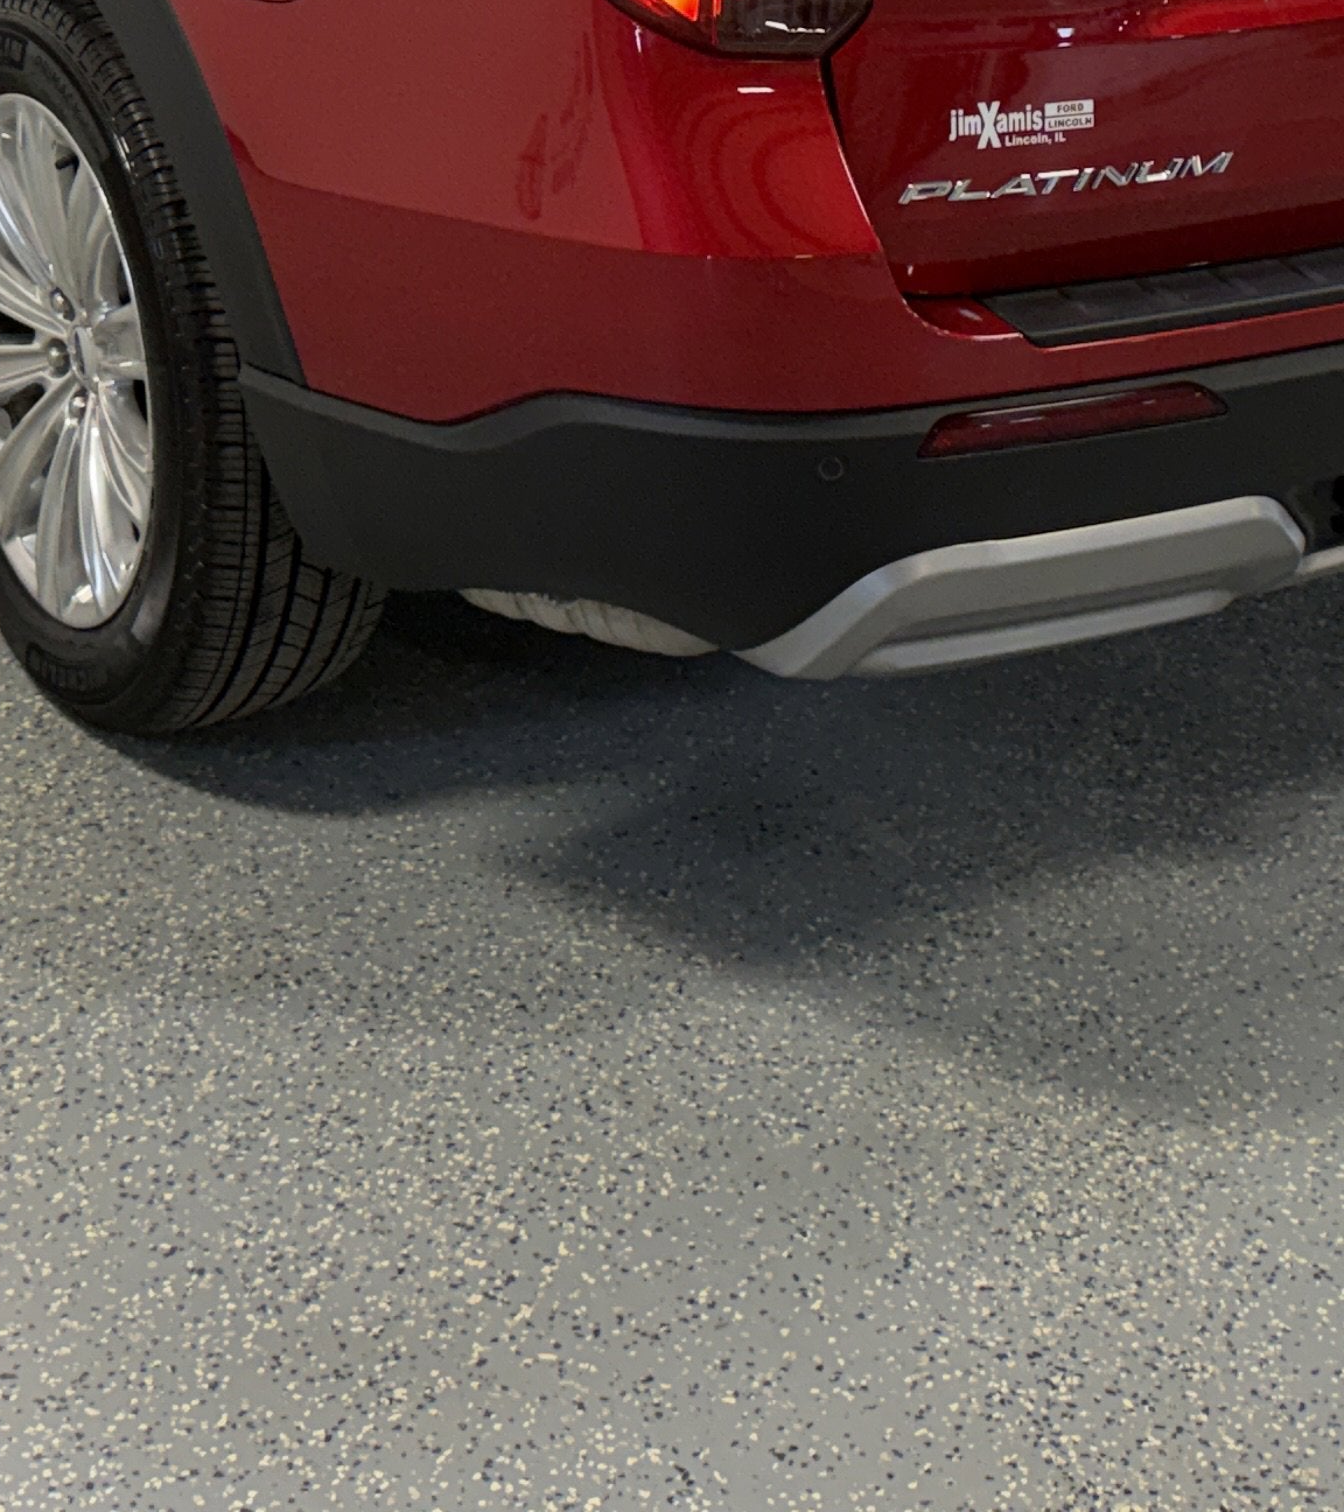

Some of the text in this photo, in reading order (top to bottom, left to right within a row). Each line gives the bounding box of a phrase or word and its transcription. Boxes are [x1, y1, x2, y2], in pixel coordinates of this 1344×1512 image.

[1057, 103, 1084, 113] FORD
[1048, 117, 1092, 128] LINCOLN
[1005, 132, 1066, 147] Lincoln, IL
[898, 151, 1234, 205] PLATINUM
